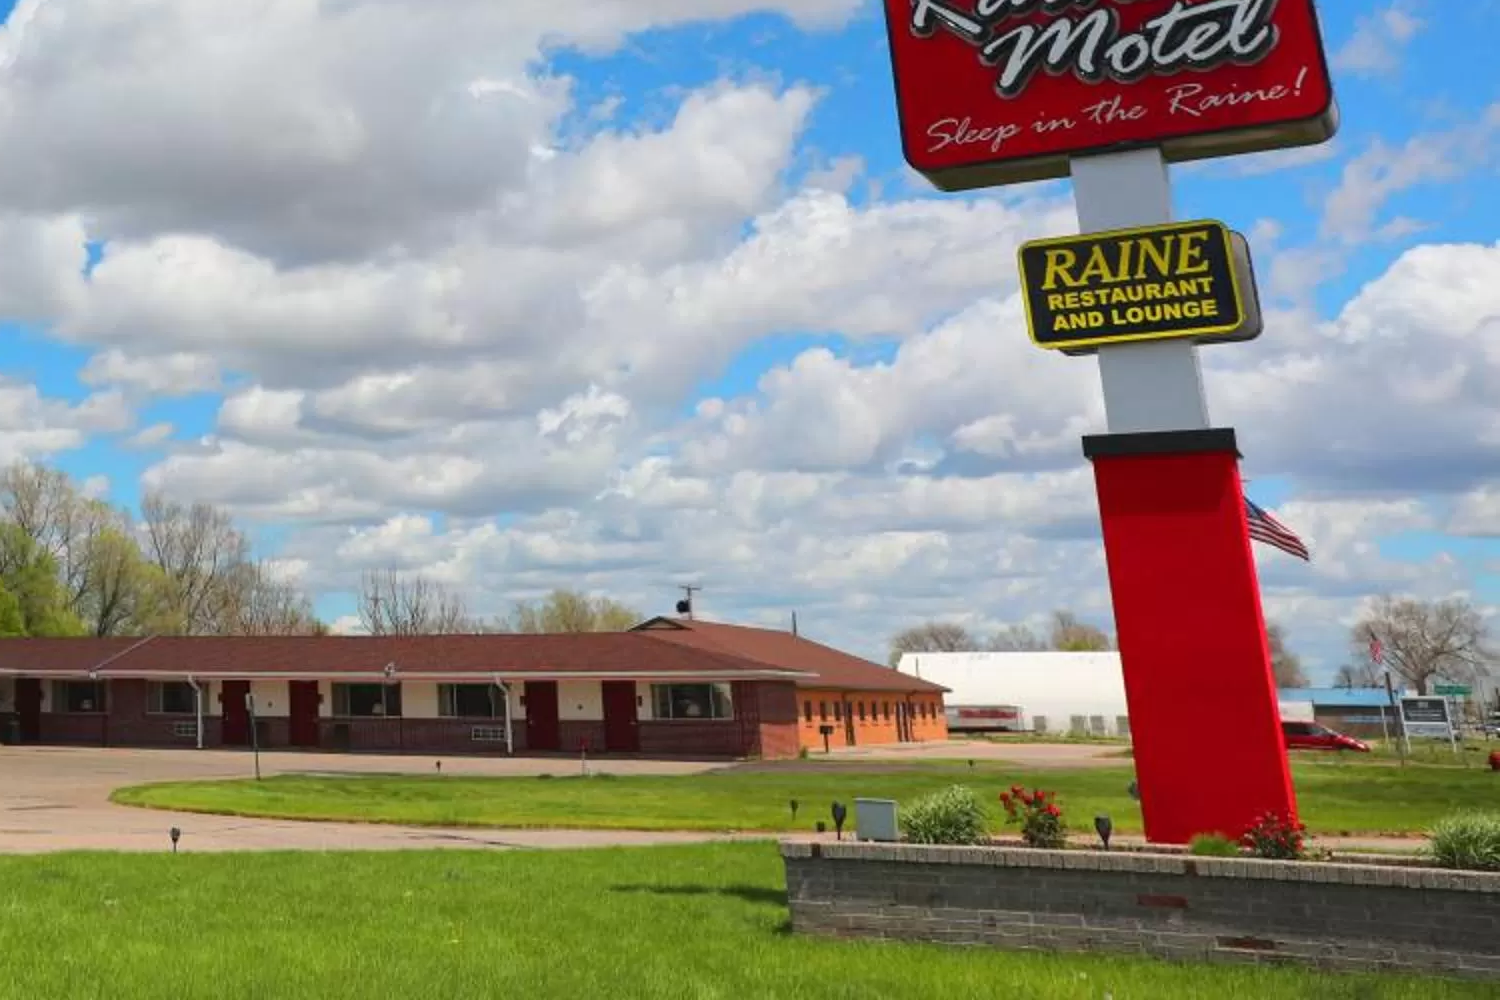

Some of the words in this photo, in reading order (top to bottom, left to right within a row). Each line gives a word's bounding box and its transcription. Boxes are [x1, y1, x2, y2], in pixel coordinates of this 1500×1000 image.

[927, 116, 1020, 153] Sleep
[1030, 111, 1077, 133] in
[1081, 95, 1149, 125] the
[1164, 66, 1309, 118] Raine!
[1041, 230, 1210, 290] RAINE
[1047, 276, 1215, 311] RESTAURANT
[1052, 310, 1105, 332] AND
[1111, 298, 1219, 326] LOUNGE
